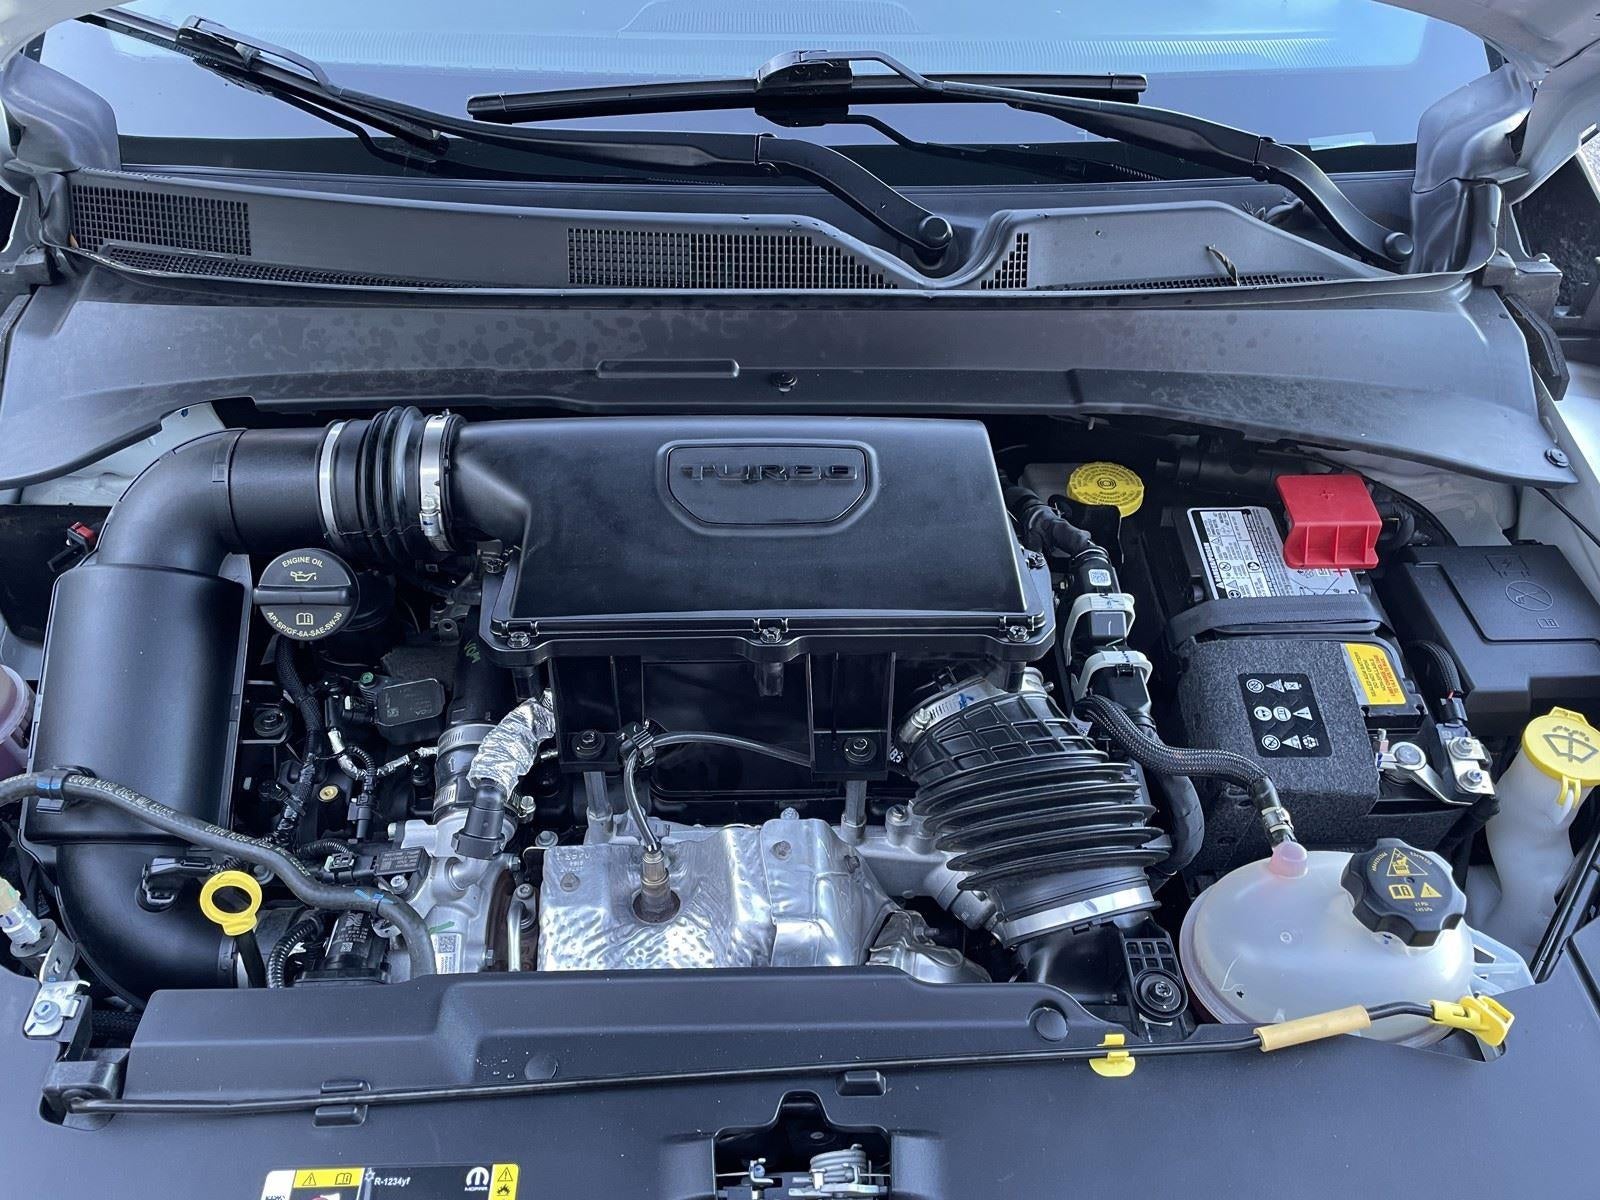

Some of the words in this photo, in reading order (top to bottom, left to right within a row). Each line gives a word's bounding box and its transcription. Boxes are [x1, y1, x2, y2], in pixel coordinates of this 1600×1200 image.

[681, 463, 858, 481] TURBO
[282, 557, 310, 567] ENGINE
[312, 559, 323, 567] OIL
[267, 612, 278, 624] API
[374, 1177, 411, 1187] R-1234yf
